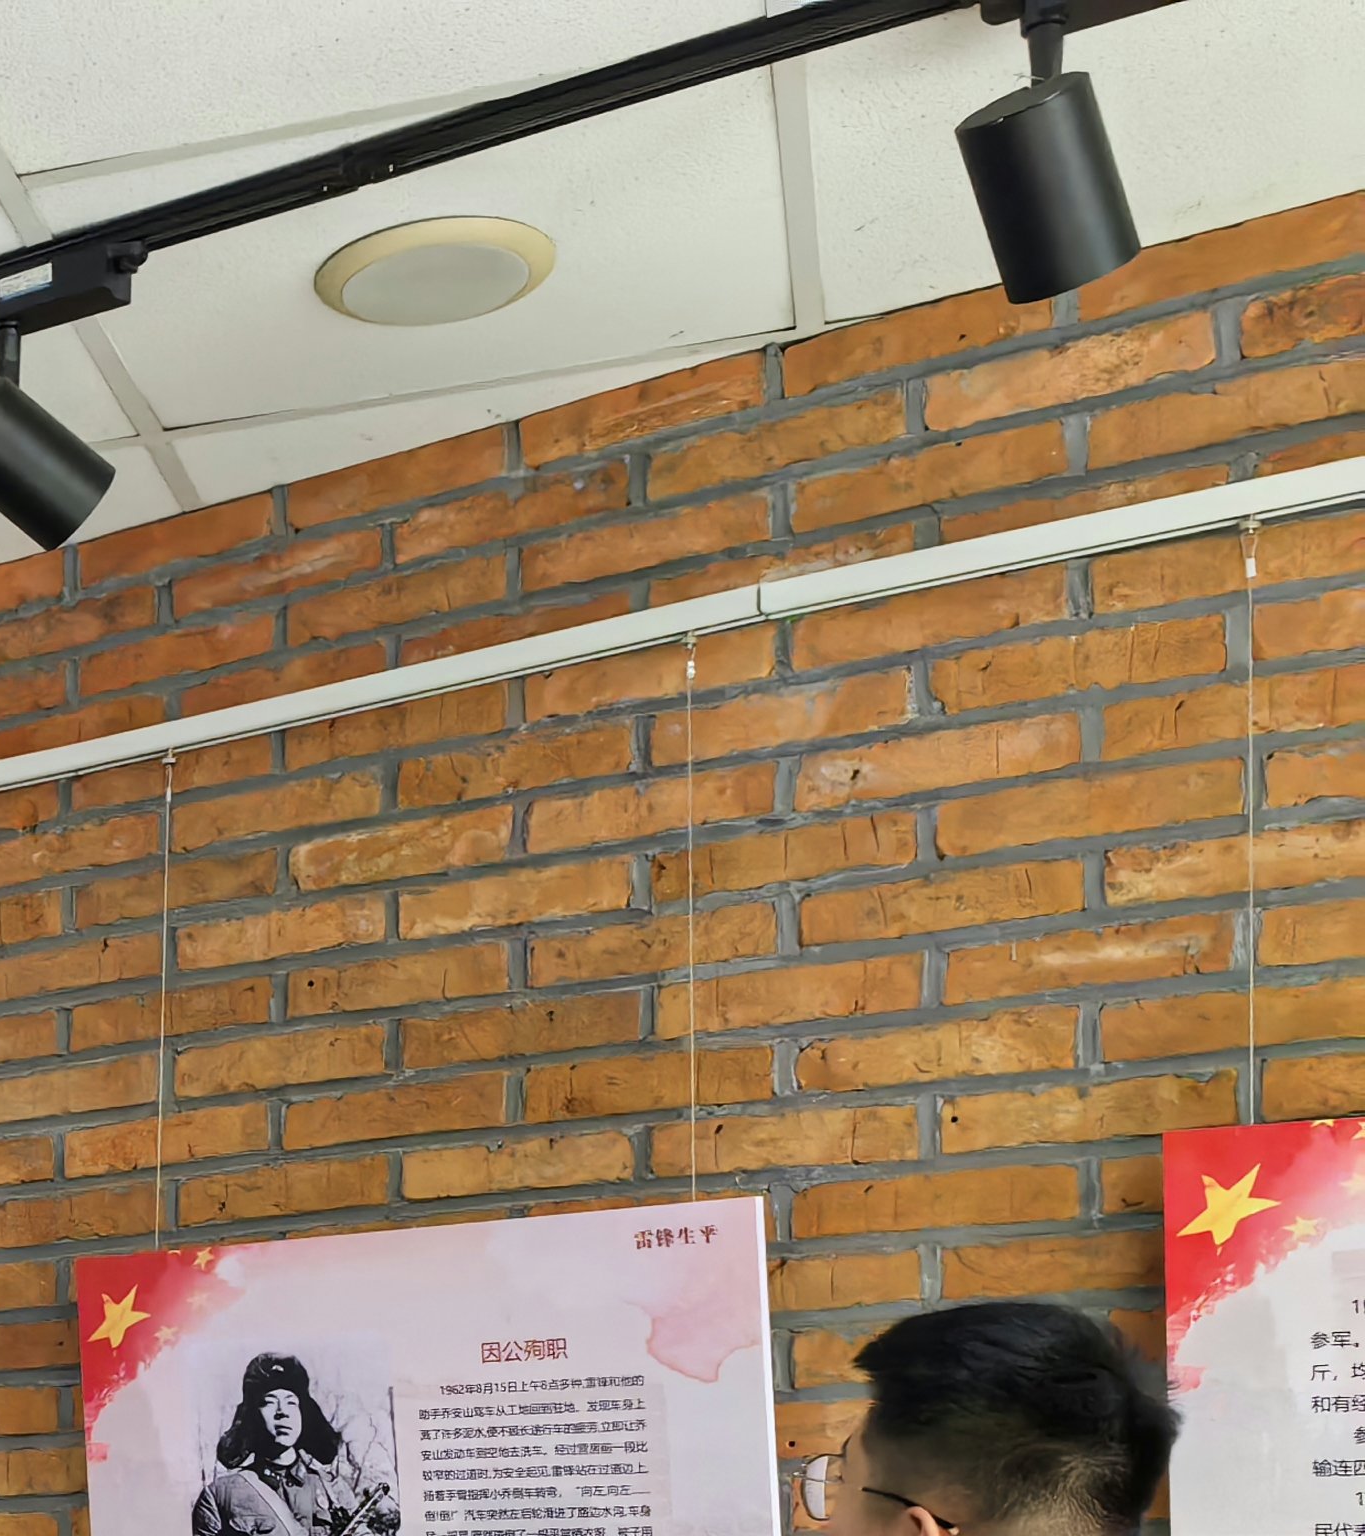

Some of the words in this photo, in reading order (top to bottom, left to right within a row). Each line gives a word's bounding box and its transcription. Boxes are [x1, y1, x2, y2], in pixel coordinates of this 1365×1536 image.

[634, 1224, 718, 1249] 雷锋生平
[481, 1338, 568, 1363] 因公殉职
